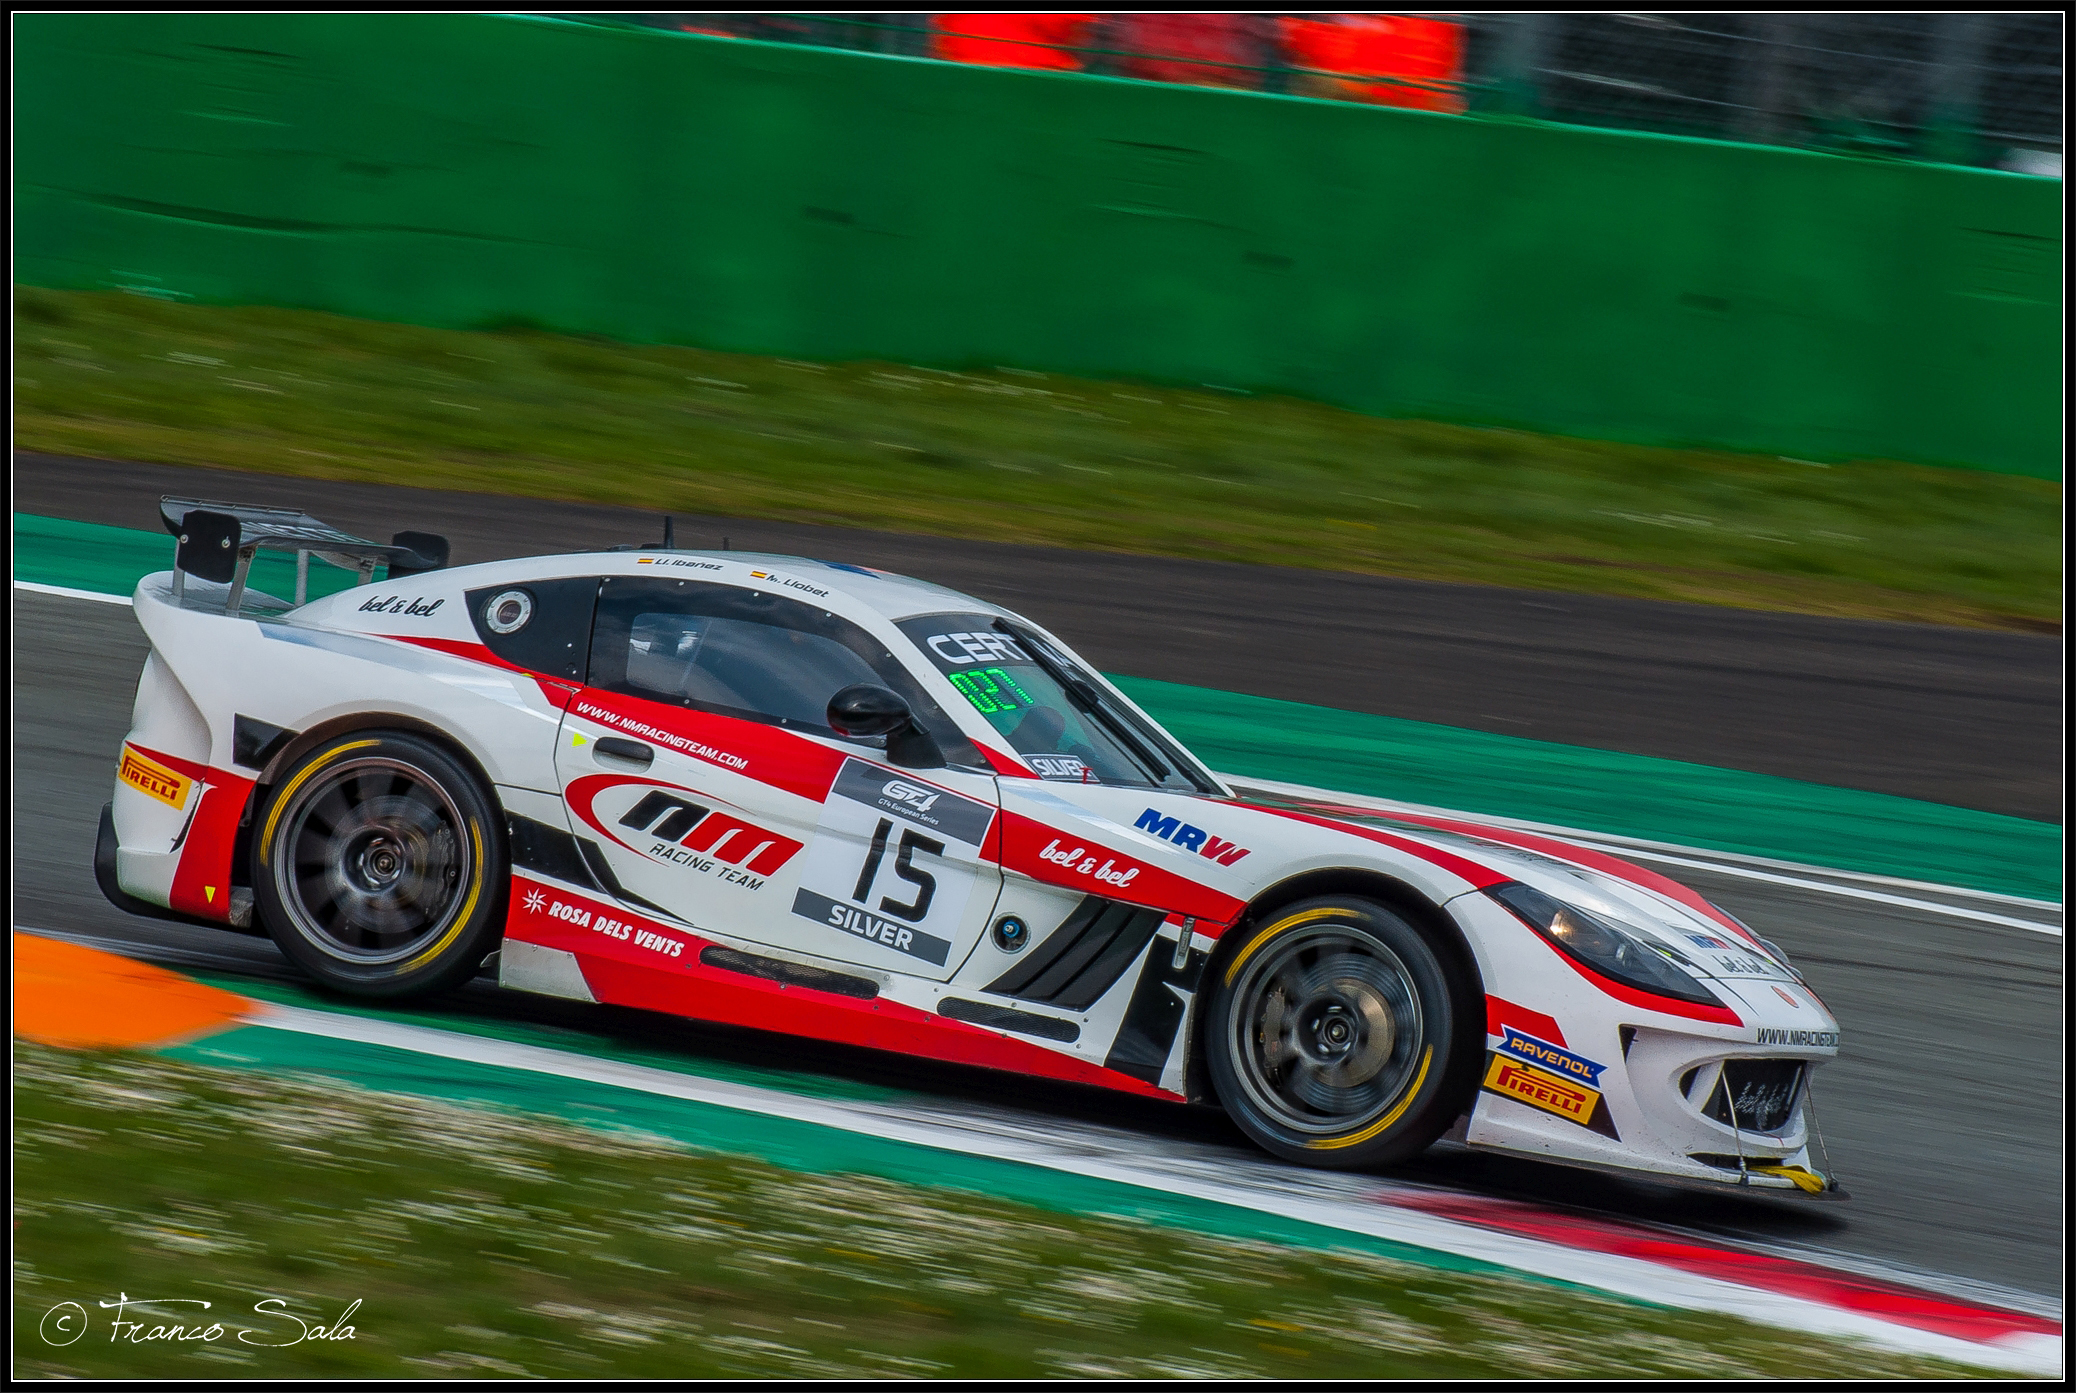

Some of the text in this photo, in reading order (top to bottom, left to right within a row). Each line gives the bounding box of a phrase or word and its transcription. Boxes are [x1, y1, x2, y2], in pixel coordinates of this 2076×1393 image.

[358, 595, 445, 617] bel & bel
[576, 701, 749, 770] WWW.NMRACINGTEAM.COM
[122, 754, 181, 801] PIRELLI
[1032, 758, 1092, 778] SILVER
[877, 798, 940, 826] GT4 European Series
[881, 779, 942, 812] GT4
[1133, 807, 1252, 867] MRW
[650, 843, 765, 892] RACING TEAM
[851, 816, 946, 923] 15
[1039, 838, 1140, 888] bel & bel
[548, 901, 685, 958] ROSA DELS VENTS
[828, 904, 913, 951] SILVER
[1510, 1037, 1594, 1078] RAVENOL
[1496, 1064, 1587, 1115] PIRELLI
